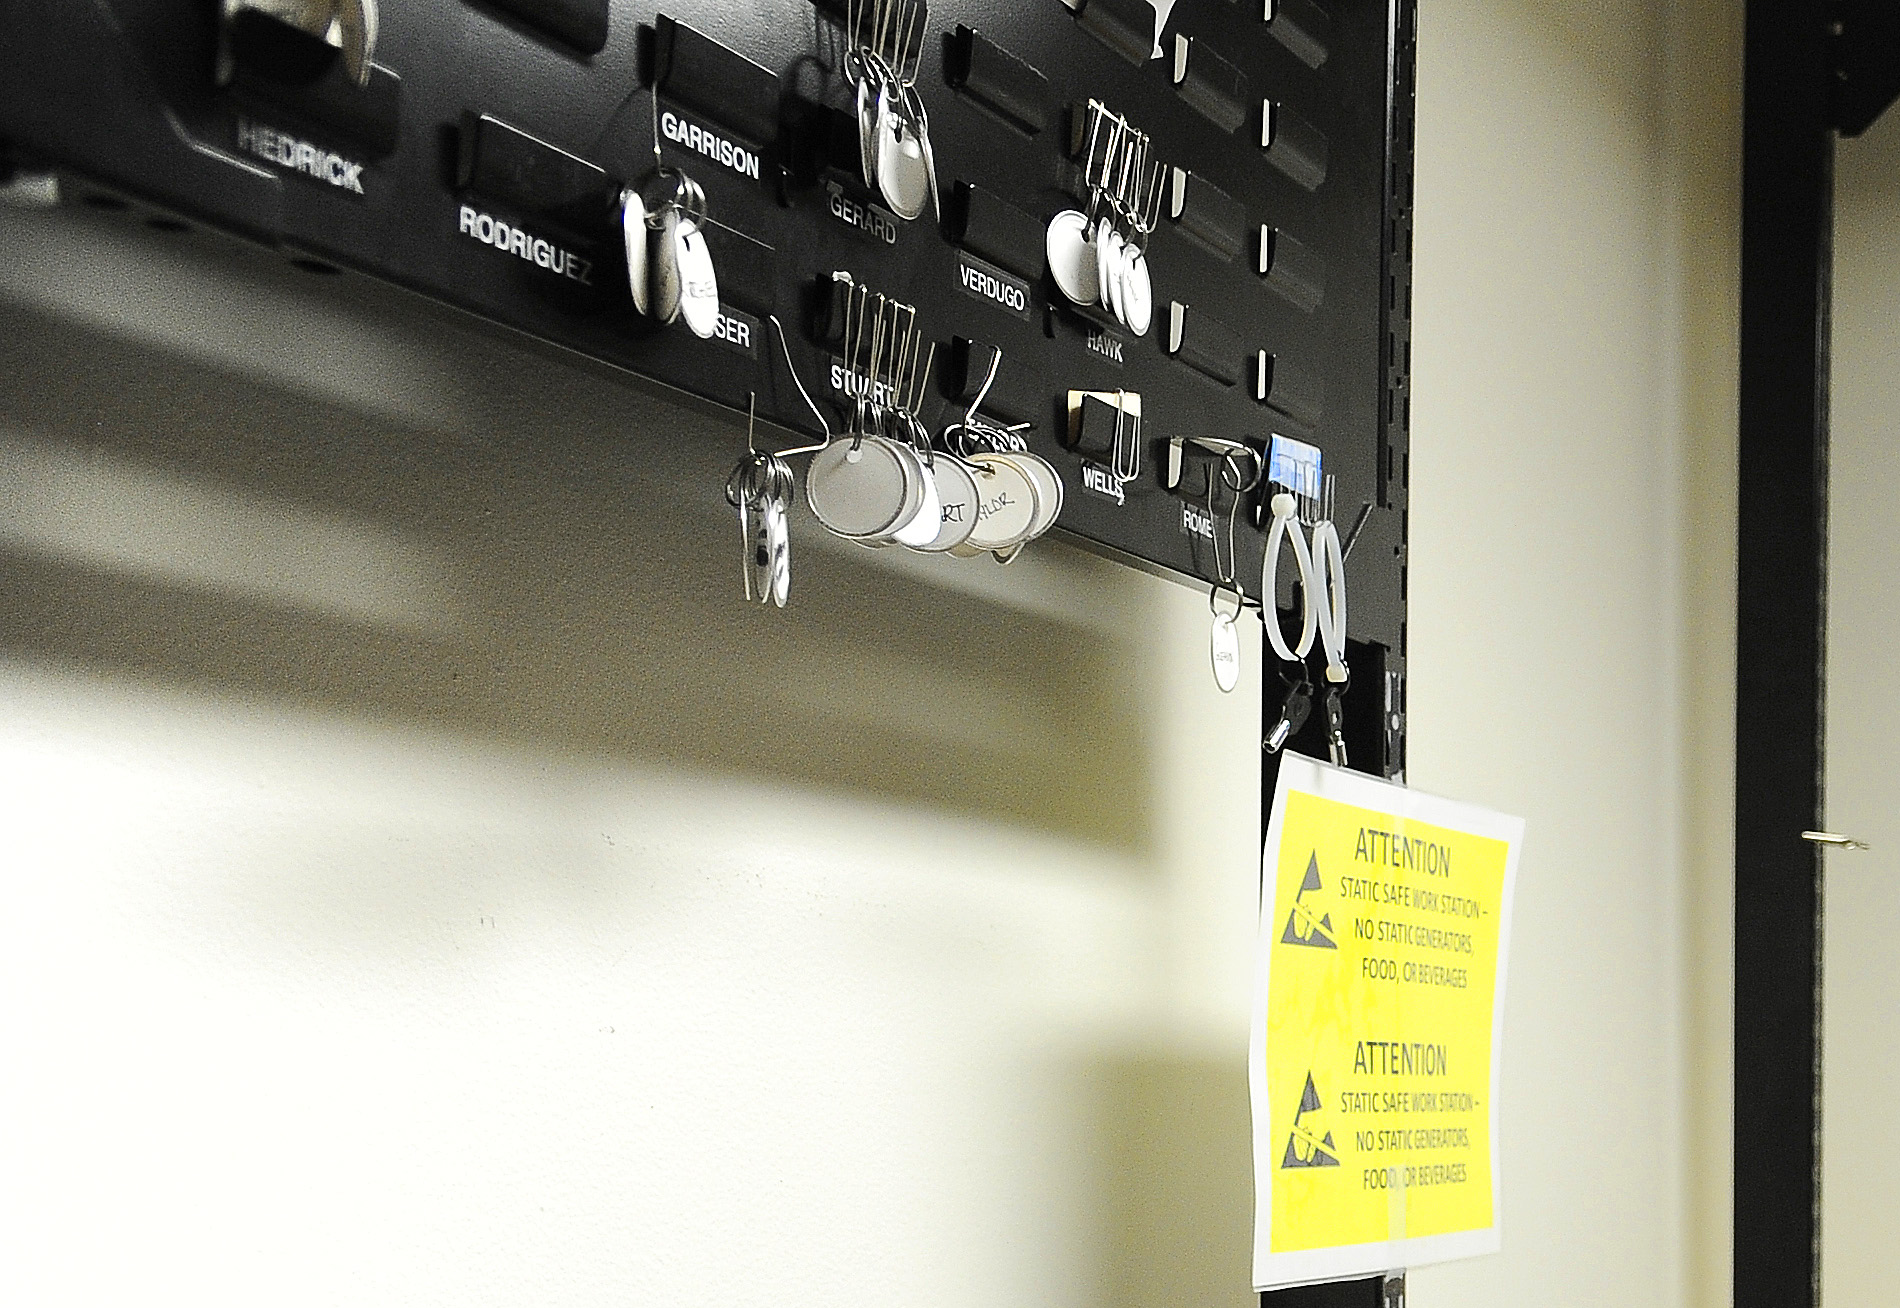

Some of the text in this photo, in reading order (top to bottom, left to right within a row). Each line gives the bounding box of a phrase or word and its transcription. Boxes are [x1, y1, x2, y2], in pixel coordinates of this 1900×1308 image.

[238, 118, 364, 194] HEDRICK
[662, 112, 759, 179] GARRISON
[830, 193, 896, 244] GERARD
[459, 205, 592, 286] RODRIGUEZ
[960, 263, 1025, 311] VERDUGO
[1087, 329, 1123, 363] HAWK
[1082, 466, 1124, 499] WELLS
[1355, 827, 1451, 878] ATTENTION
[1341, 876, 1380, 902] STATIC
[1383, 883, 1410, 907] SAFE
[1413, 888, 1439, 912] WORK
[1442, 895, 1480, 919] STATION
[1355, 917, 1374, 940] NO
[1378, 920, 1413, 945] STATIC
[1363, 957, 1468, 989] FOOD, OR BEVERAGES
[1354, 1041, 1447, 1076] ATTENTION
[1341, 1091, 1379, 1113] STATIC
[1383, 1091, 1409, 1113] SAFE
[1412, 1092, 1437, 1113] WORK
[1440, 1092, 1473, 1113] STATION
[1356, 1131, 1374, 1152] NO
[1378, 1129, 1412, 1151] STATIC
[1404, 1167, 1416, 1188] OR
[1419, 1164, 1467, 1187] BEVERAGES
